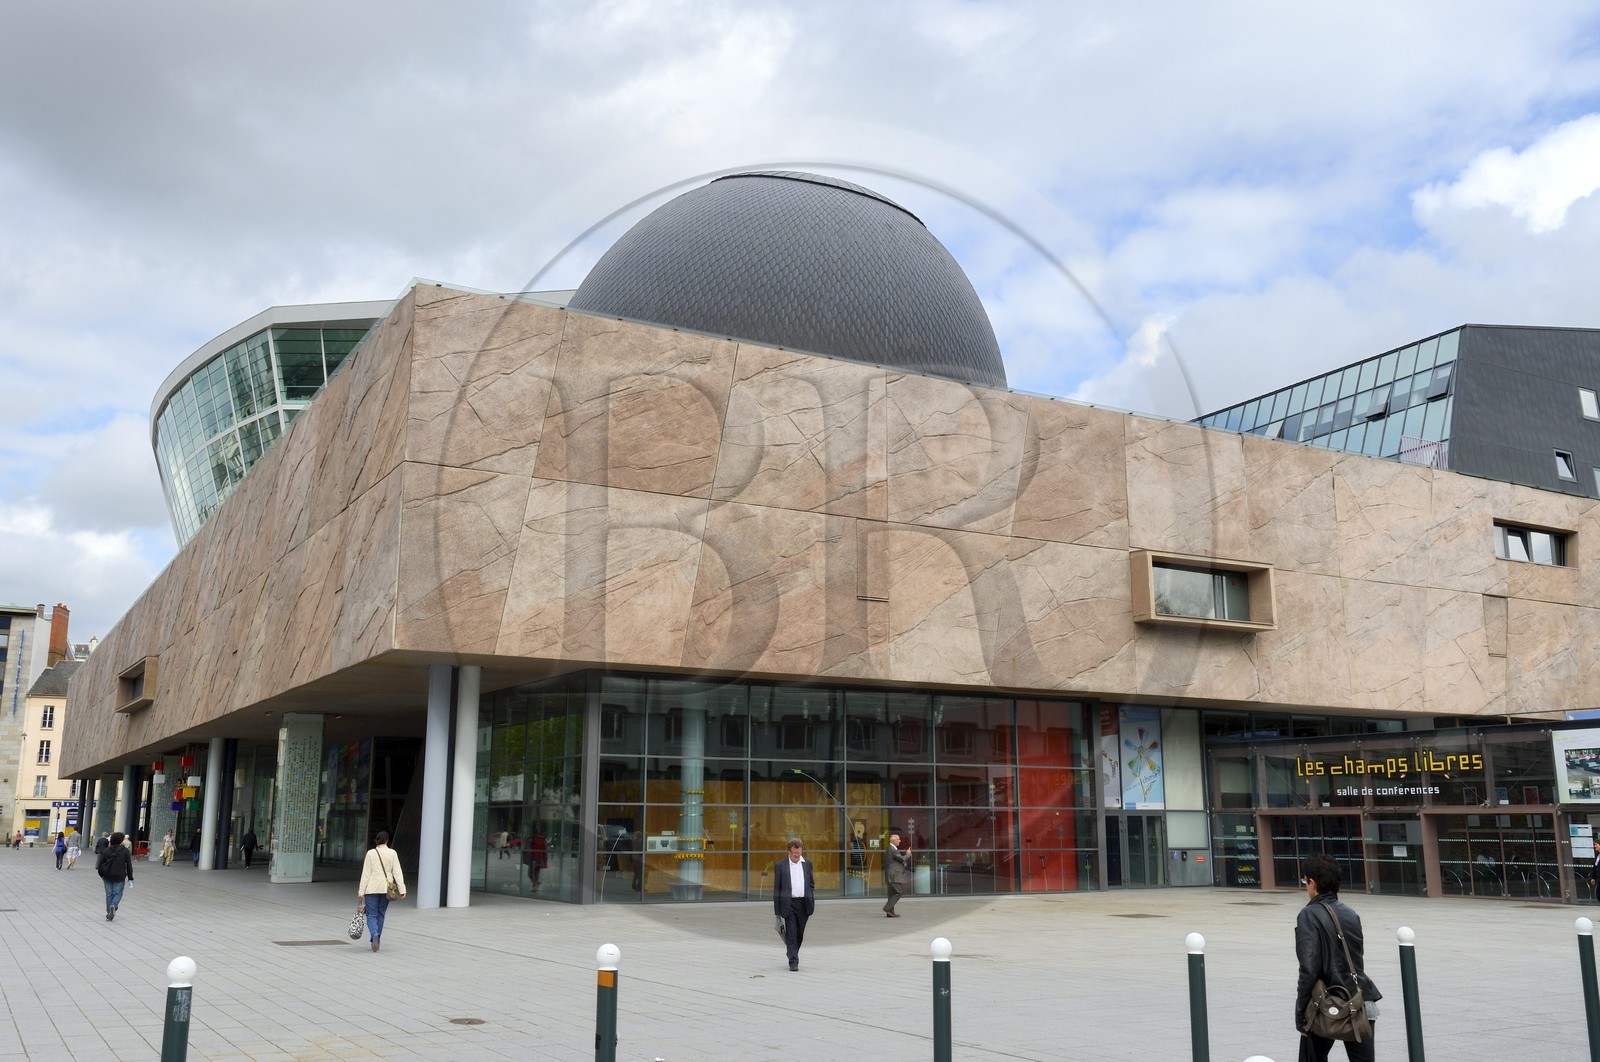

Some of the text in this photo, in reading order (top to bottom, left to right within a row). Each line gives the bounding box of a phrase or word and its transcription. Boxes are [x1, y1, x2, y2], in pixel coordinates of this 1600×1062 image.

[1296, 750, 1483, 778] les champs libres
[1336, 784, 1440, 796] salle de conférences
